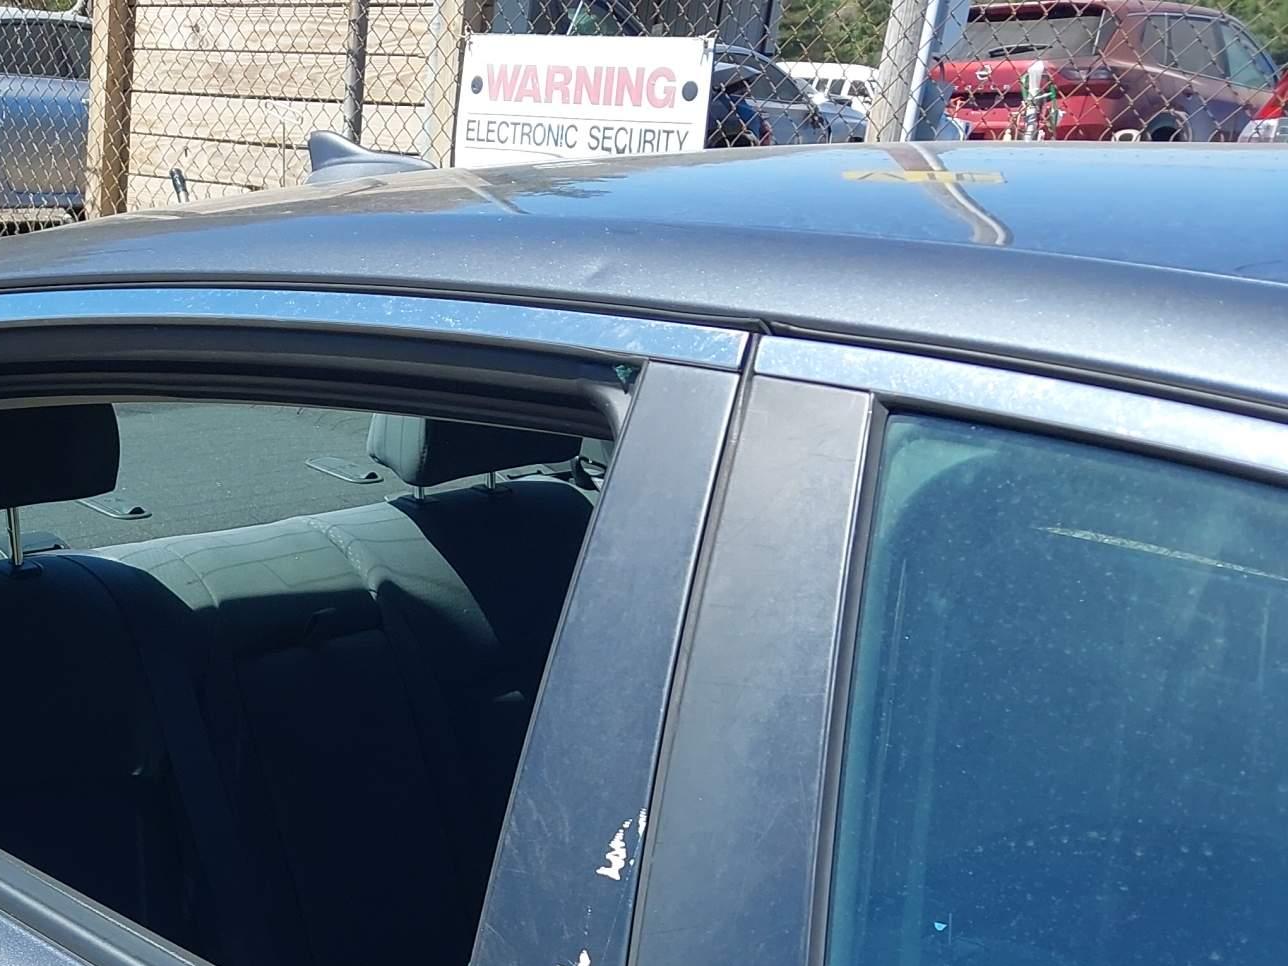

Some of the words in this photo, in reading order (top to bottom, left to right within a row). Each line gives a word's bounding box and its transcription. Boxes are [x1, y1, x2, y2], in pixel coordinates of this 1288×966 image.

[486, 63, 677, 109] WARNING
[465, 119, 578, 148] ELECTRONIC
[587, 124, 690, 154] SECURITY
